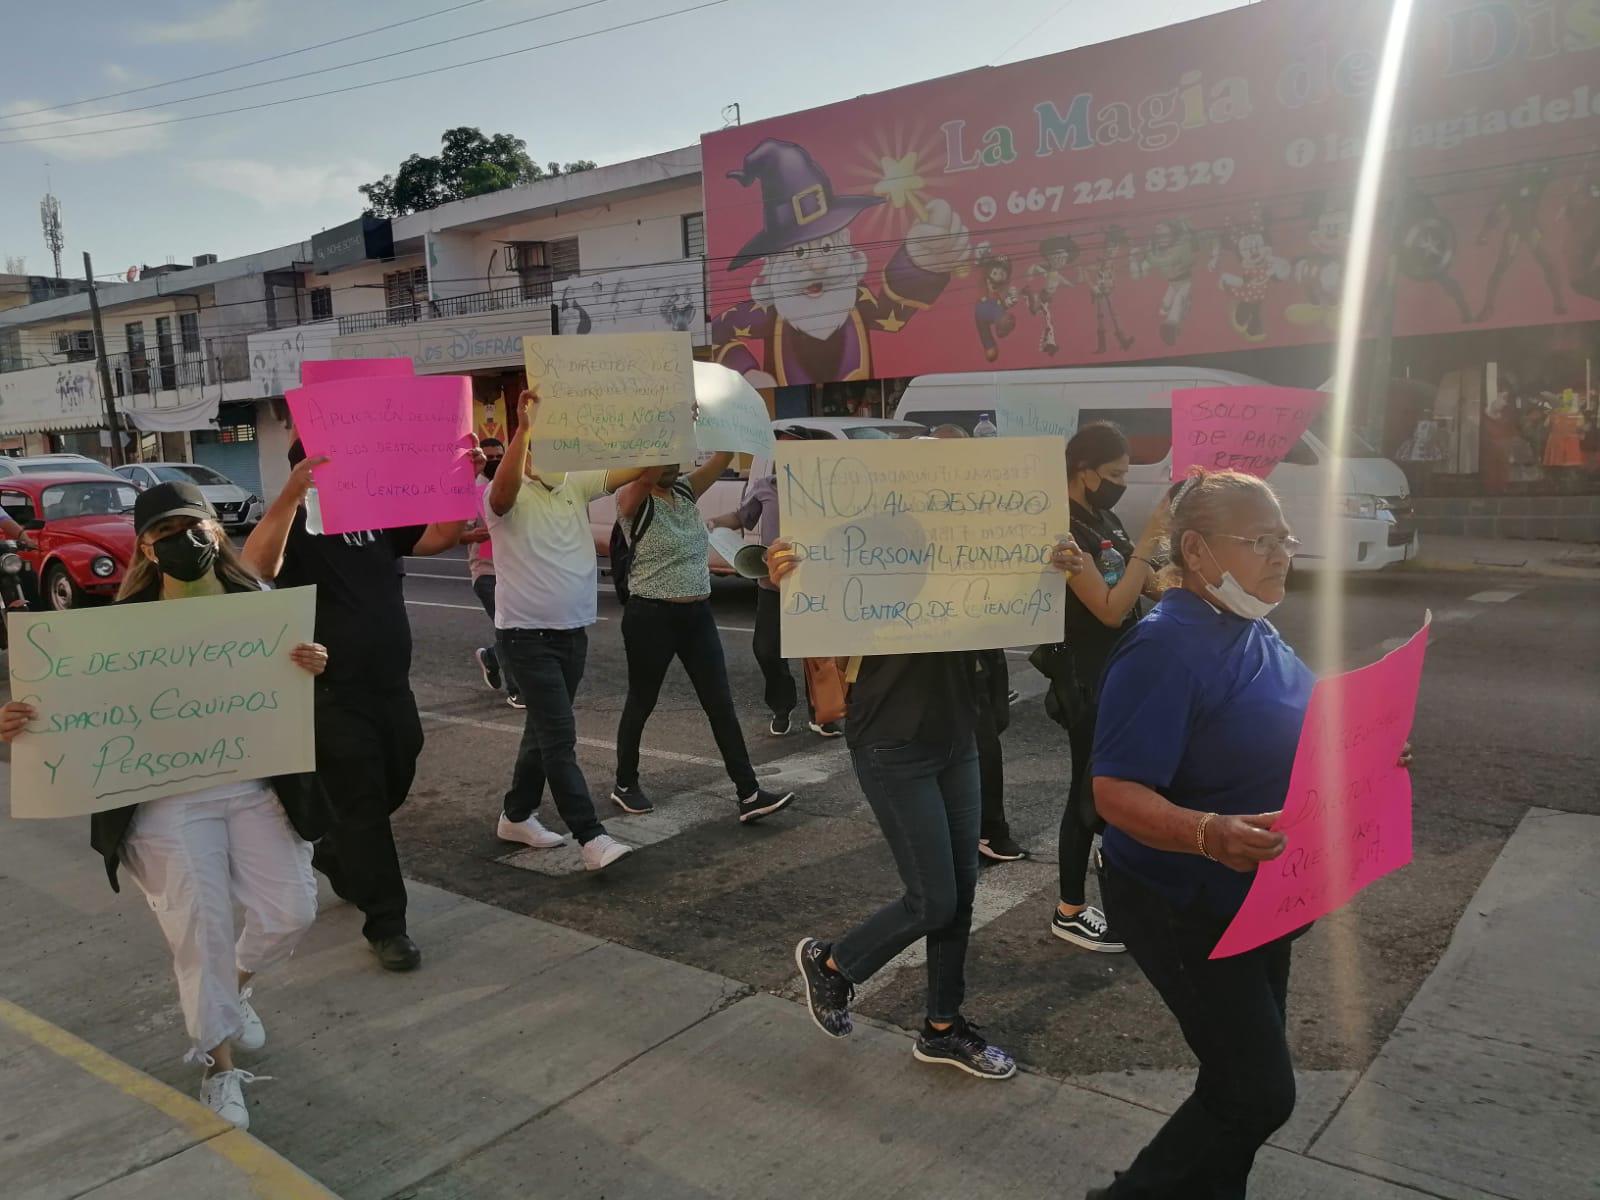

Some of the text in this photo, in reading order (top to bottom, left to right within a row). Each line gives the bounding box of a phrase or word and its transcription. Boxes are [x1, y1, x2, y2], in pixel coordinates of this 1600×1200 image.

[940, 119, 1018, 173] La
[1034, 69, 1252, 157] Magia
[1276, 38, 1410, 110] de
[1007, 157, 1235, 214] 667 224 8329
[1190, 399, 1258, 421] SOLO
[552, 439, 580, 453] UNA
[1191, 430, 1227, 447] DE
[365, 467, 419, 497] CENTRO
[424, 484, 437, 495] DE
[783, 456, 1049, 518] NO AL DESPIDO
[791, 541, 834, 562] DEL
[843, 525, 949, 577] PERSONAL
[785, 591, 828, 615] DEL
[843, 577, 922, 628] CENTRO
[925, 601, 957, 618] DE
[11, 622, 288, 682] SE DESTRUYERON
[150, 688, 279, 721] EQUIPOS
[43, 754, 65, 785] Y
